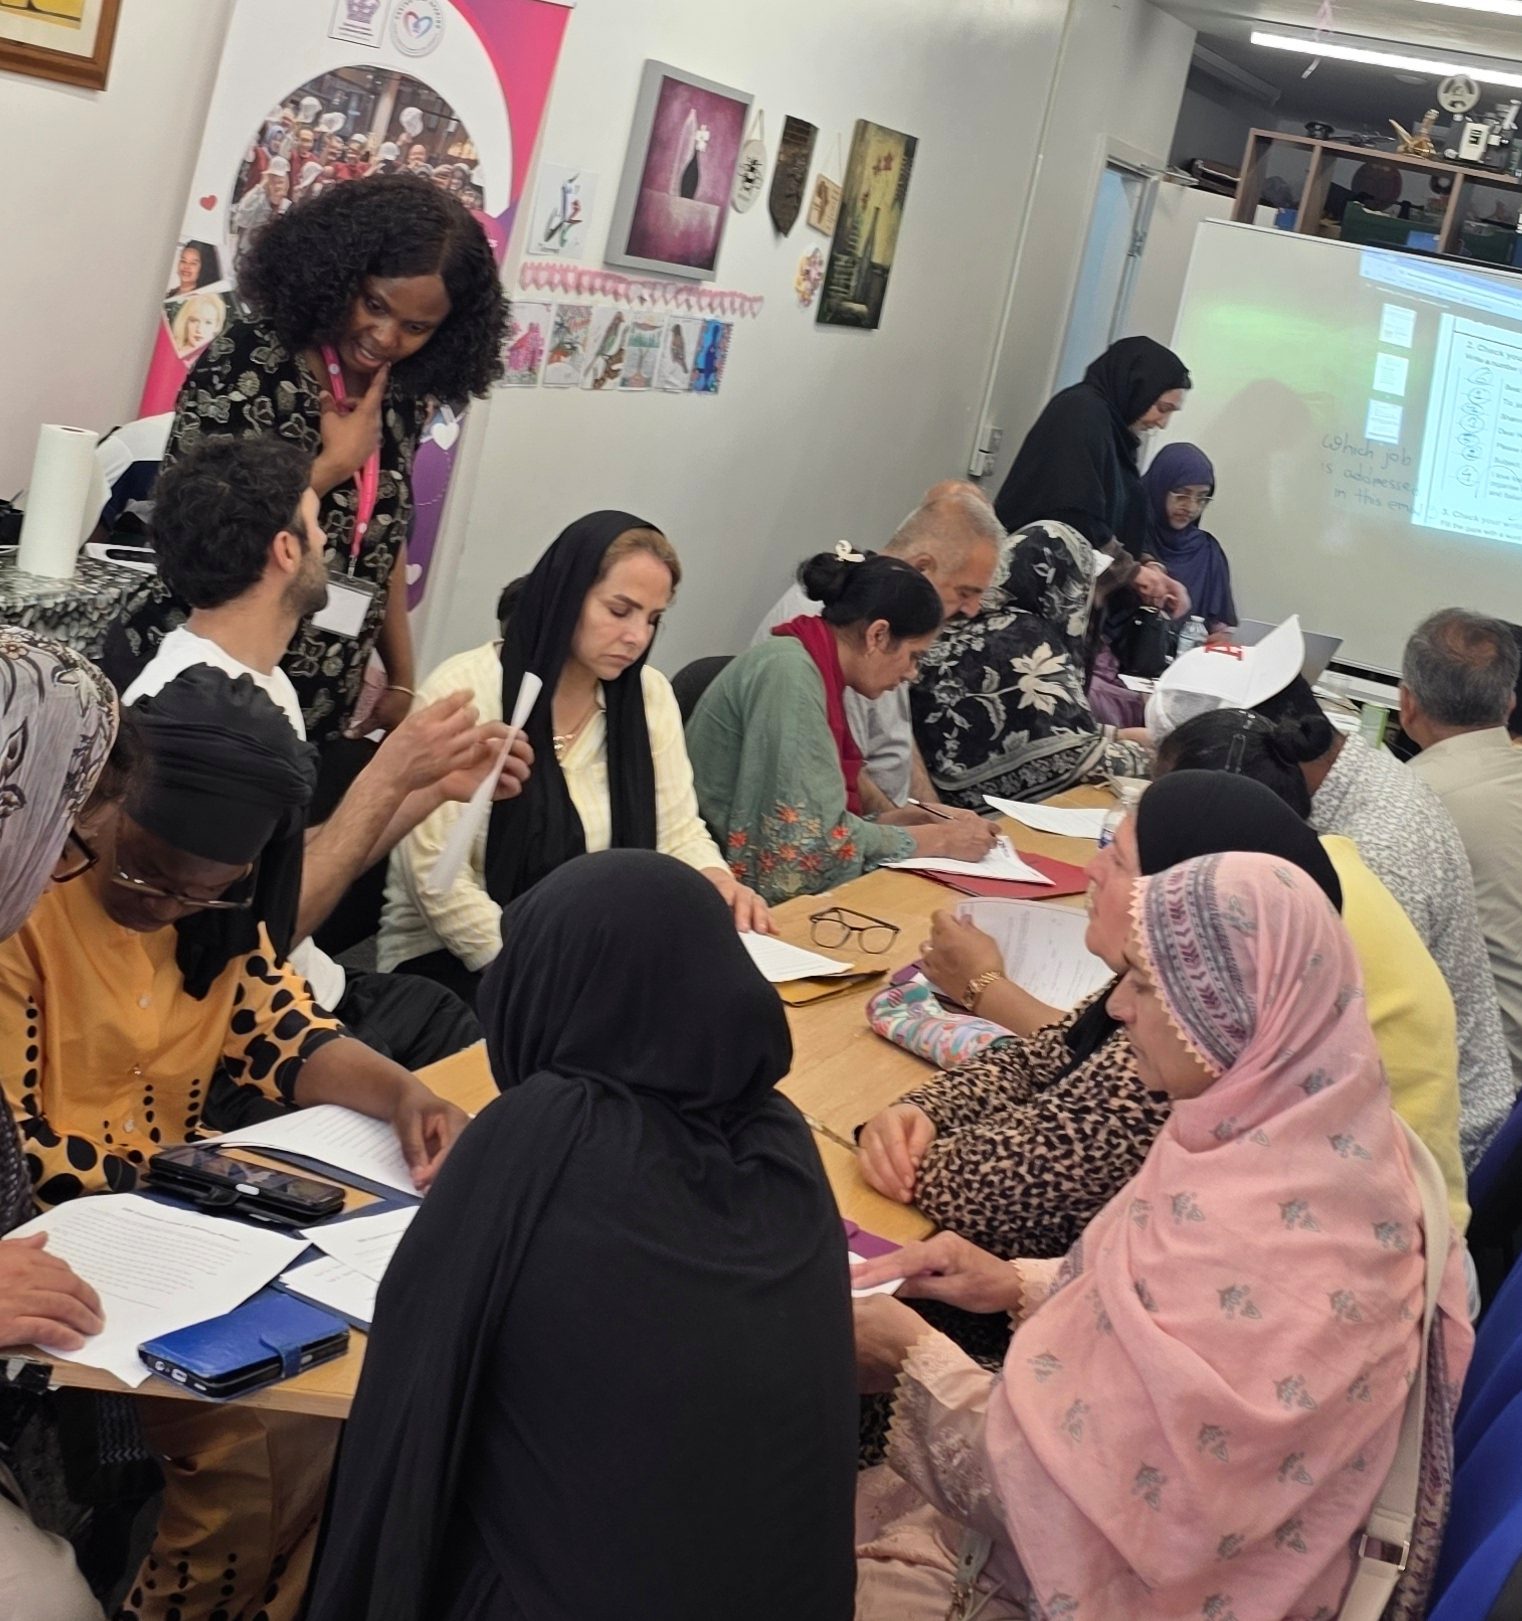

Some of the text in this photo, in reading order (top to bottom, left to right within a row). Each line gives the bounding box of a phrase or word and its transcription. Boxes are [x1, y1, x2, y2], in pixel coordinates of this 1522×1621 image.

[1321, 431, 1412, 470] Which job
[1354, 487, 1383, 507] this
